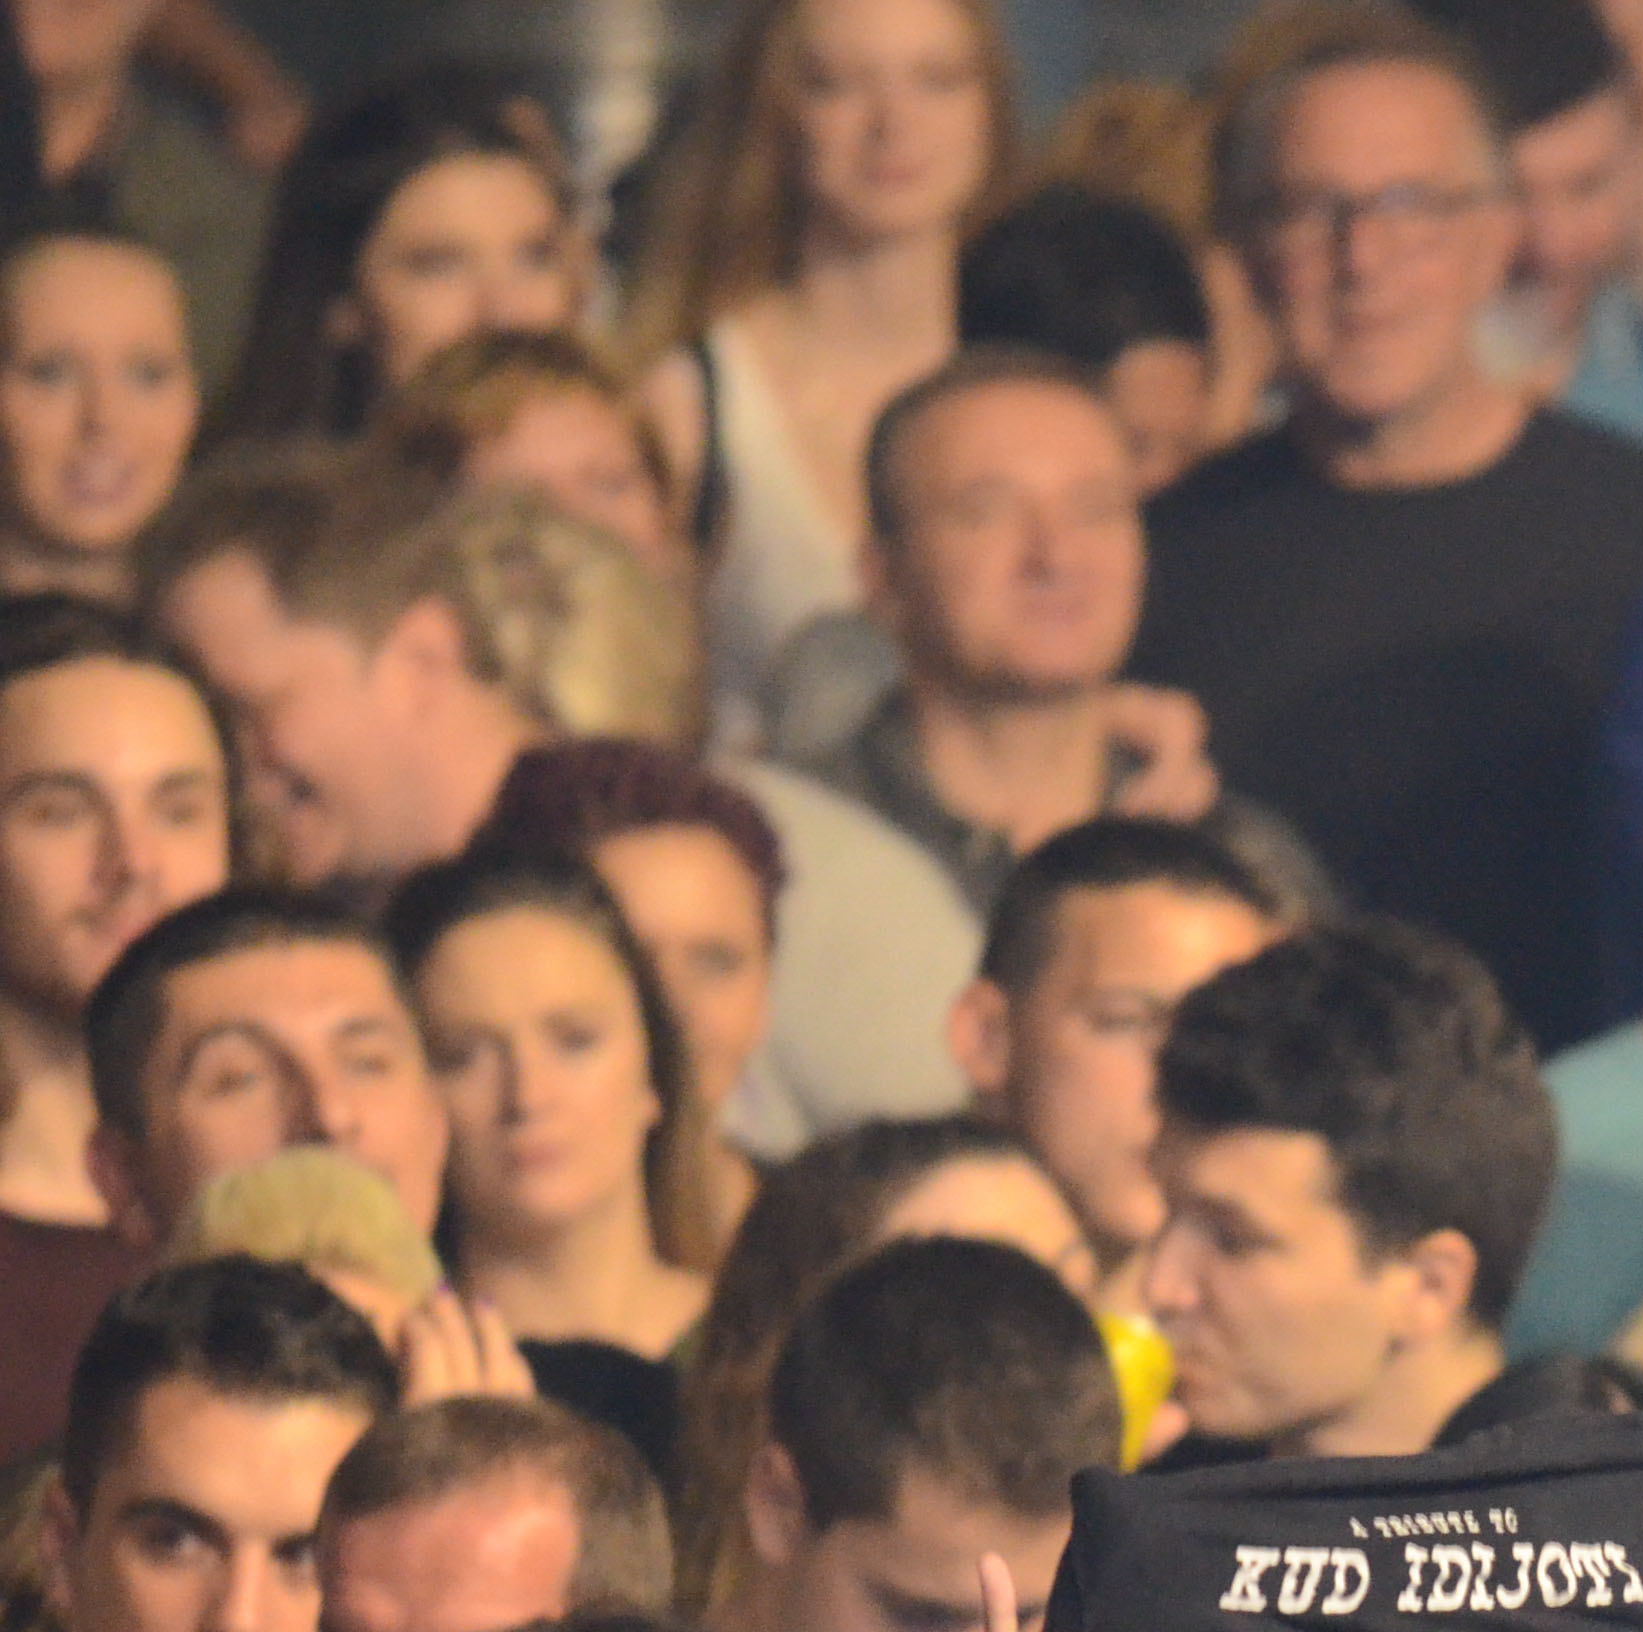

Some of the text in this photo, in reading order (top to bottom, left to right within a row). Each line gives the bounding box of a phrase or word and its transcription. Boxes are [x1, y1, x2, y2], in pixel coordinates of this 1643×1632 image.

[1349, 1506, 1519, 1539] A TRIBUTE TO
[1218, 1544, 1372, 1616] KUD
